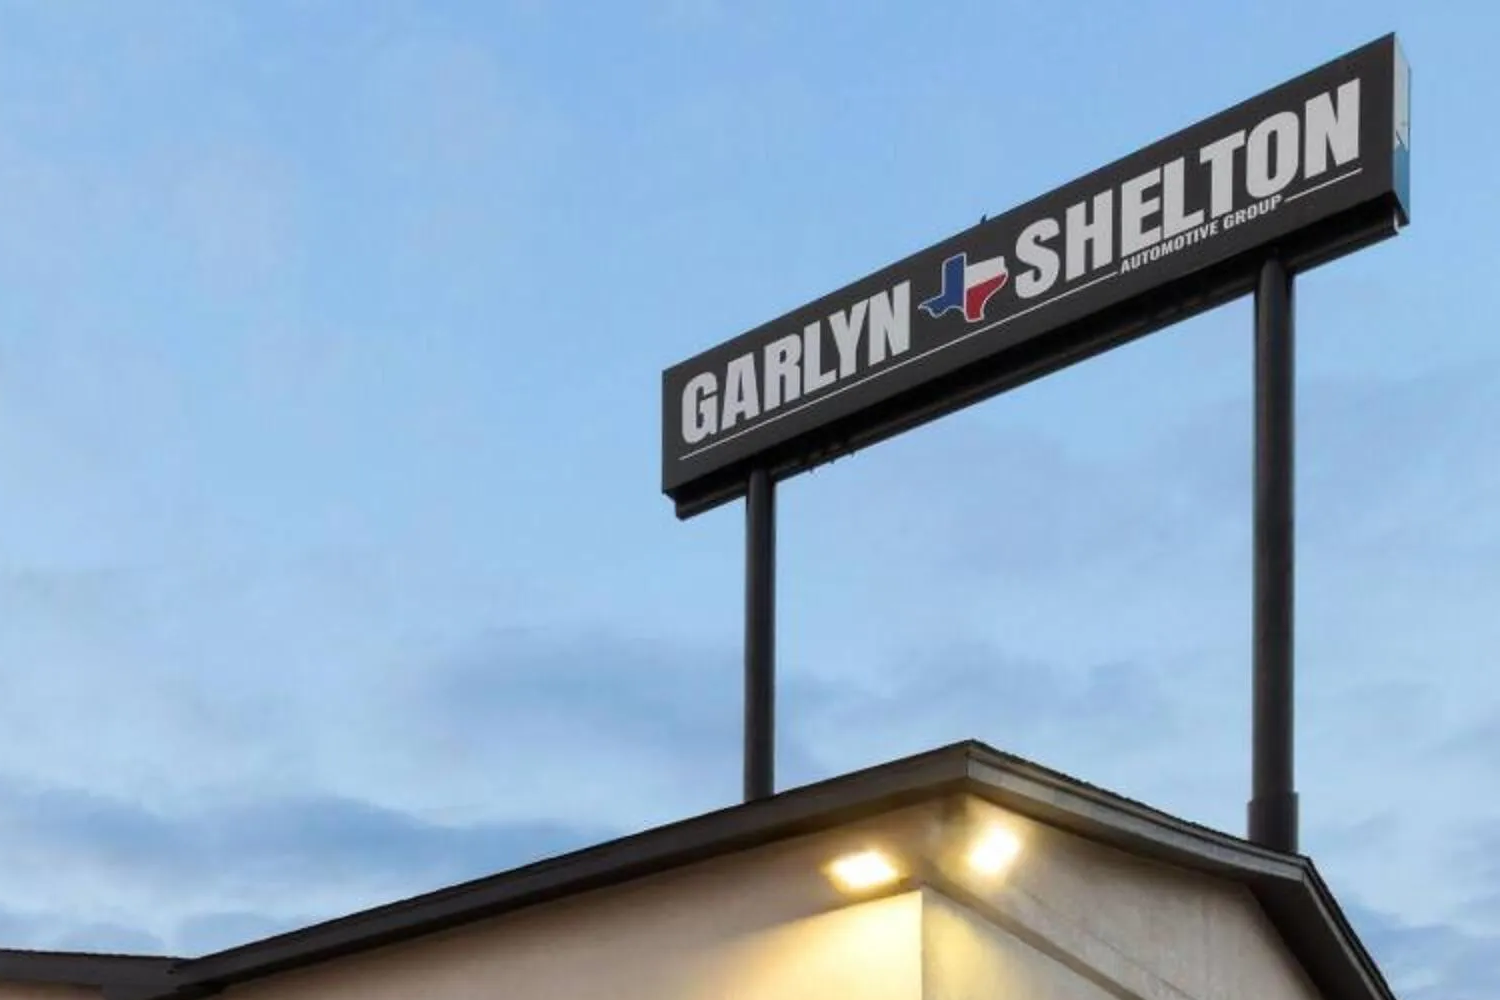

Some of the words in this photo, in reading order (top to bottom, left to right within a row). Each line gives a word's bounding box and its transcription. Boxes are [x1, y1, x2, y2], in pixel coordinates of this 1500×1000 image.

[681, 280, 911, 444] GARLYN
[1014, 78, 1361, 300] SHELTON
[1120, 221, 1219, 274] AUTOMOTIVE
[1223, 194, 1282, 230] GROUP
